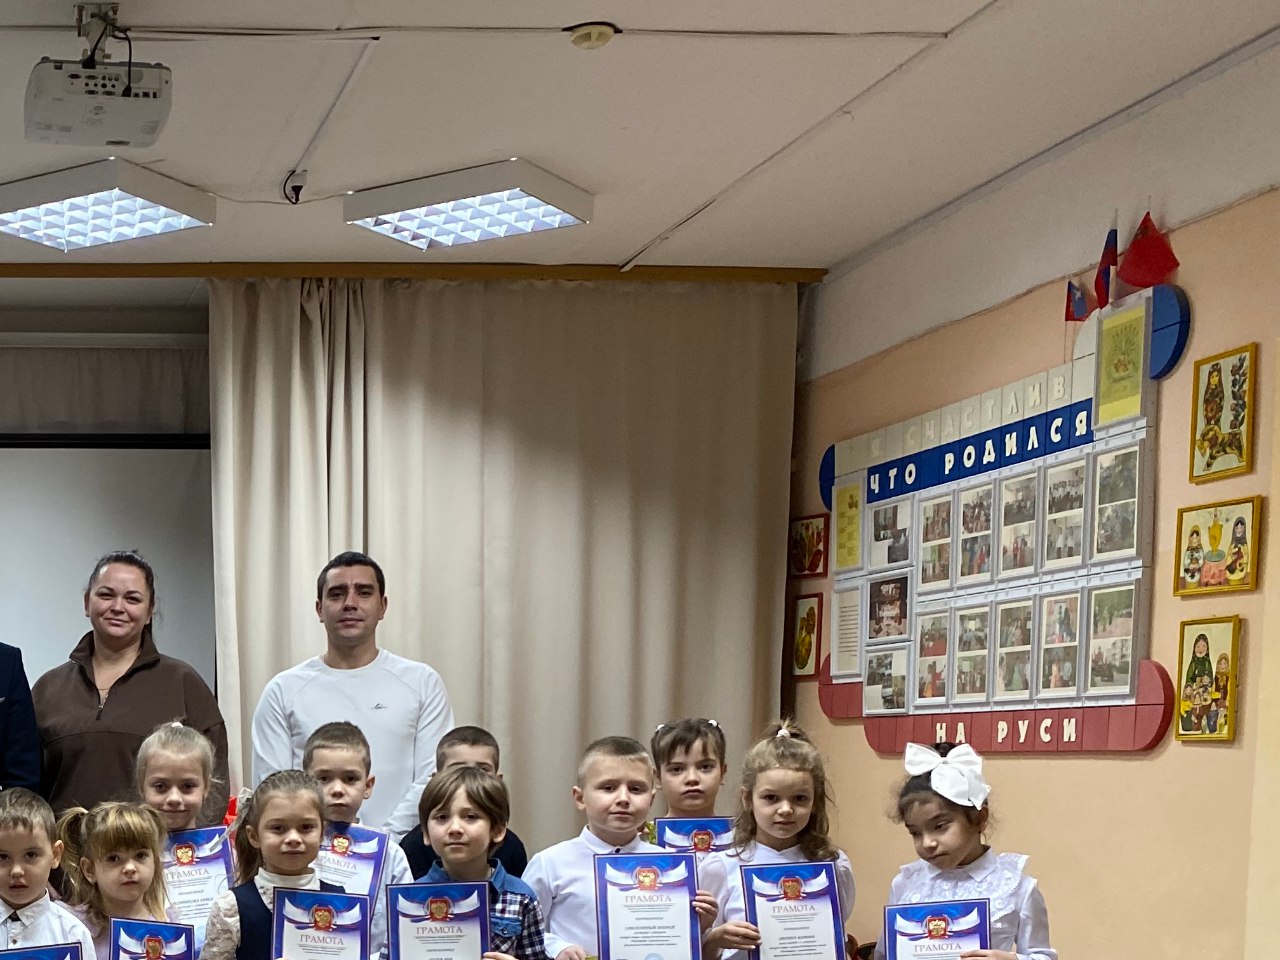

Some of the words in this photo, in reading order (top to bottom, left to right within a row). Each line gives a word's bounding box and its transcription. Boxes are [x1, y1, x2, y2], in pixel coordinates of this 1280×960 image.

[905, 375, 1066, 446] СЧАСТЛИВ
[870, 462, 916, 494] ЧТО
[944, 410, 1088, 475] РОДИЛСЯ
[935, 722, 966, 743] НА
[997, 717, 1077, 743] РУСИ
[625, 895, 672, 903] ГРАМОТА
[772, 904, 816, 914] ГРАМОТА
[416, 926, 463, 935] ГРАМОТА
[300, 934, 344, 946] ГРАМОТА
[914, 942, 962, 953] ГРАМОТА
